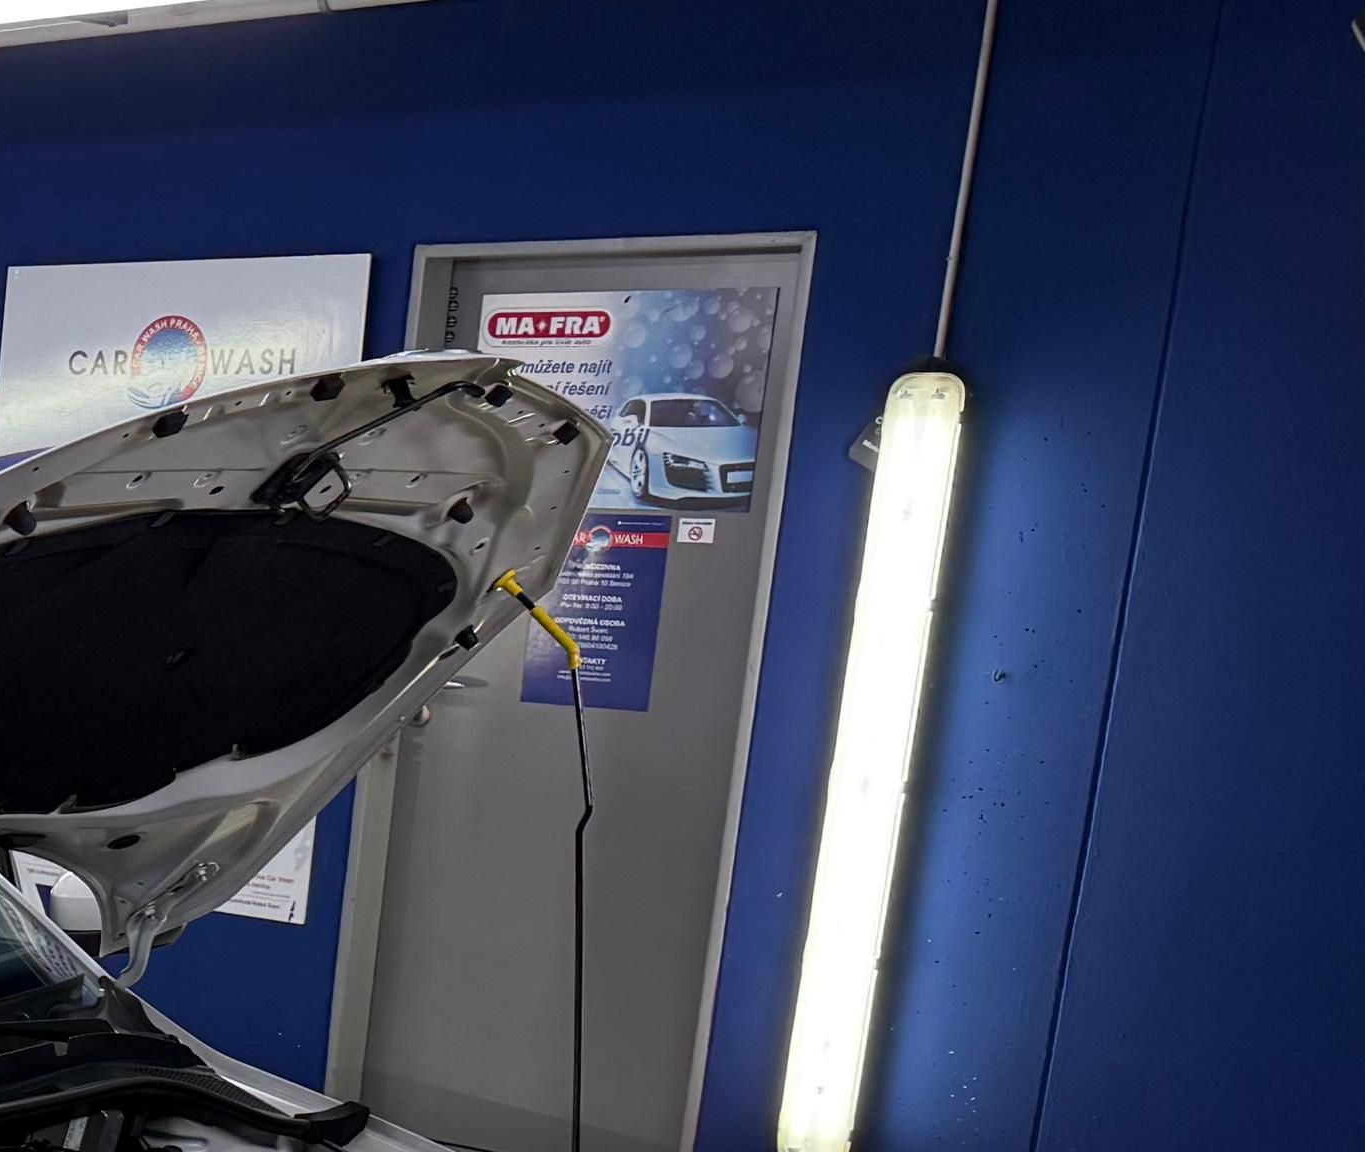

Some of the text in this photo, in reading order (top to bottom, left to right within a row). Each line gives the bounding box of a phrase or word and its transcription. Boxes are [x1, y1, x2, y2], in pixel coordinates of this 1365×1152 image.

[68, 350, 128, 377] CAR
[210, 348, 296, 376] WASH
[520, 359, 613, 377] můžete najít
[562, 381, 614, 396] řešení
[614, 534, 644, 545] WASH
